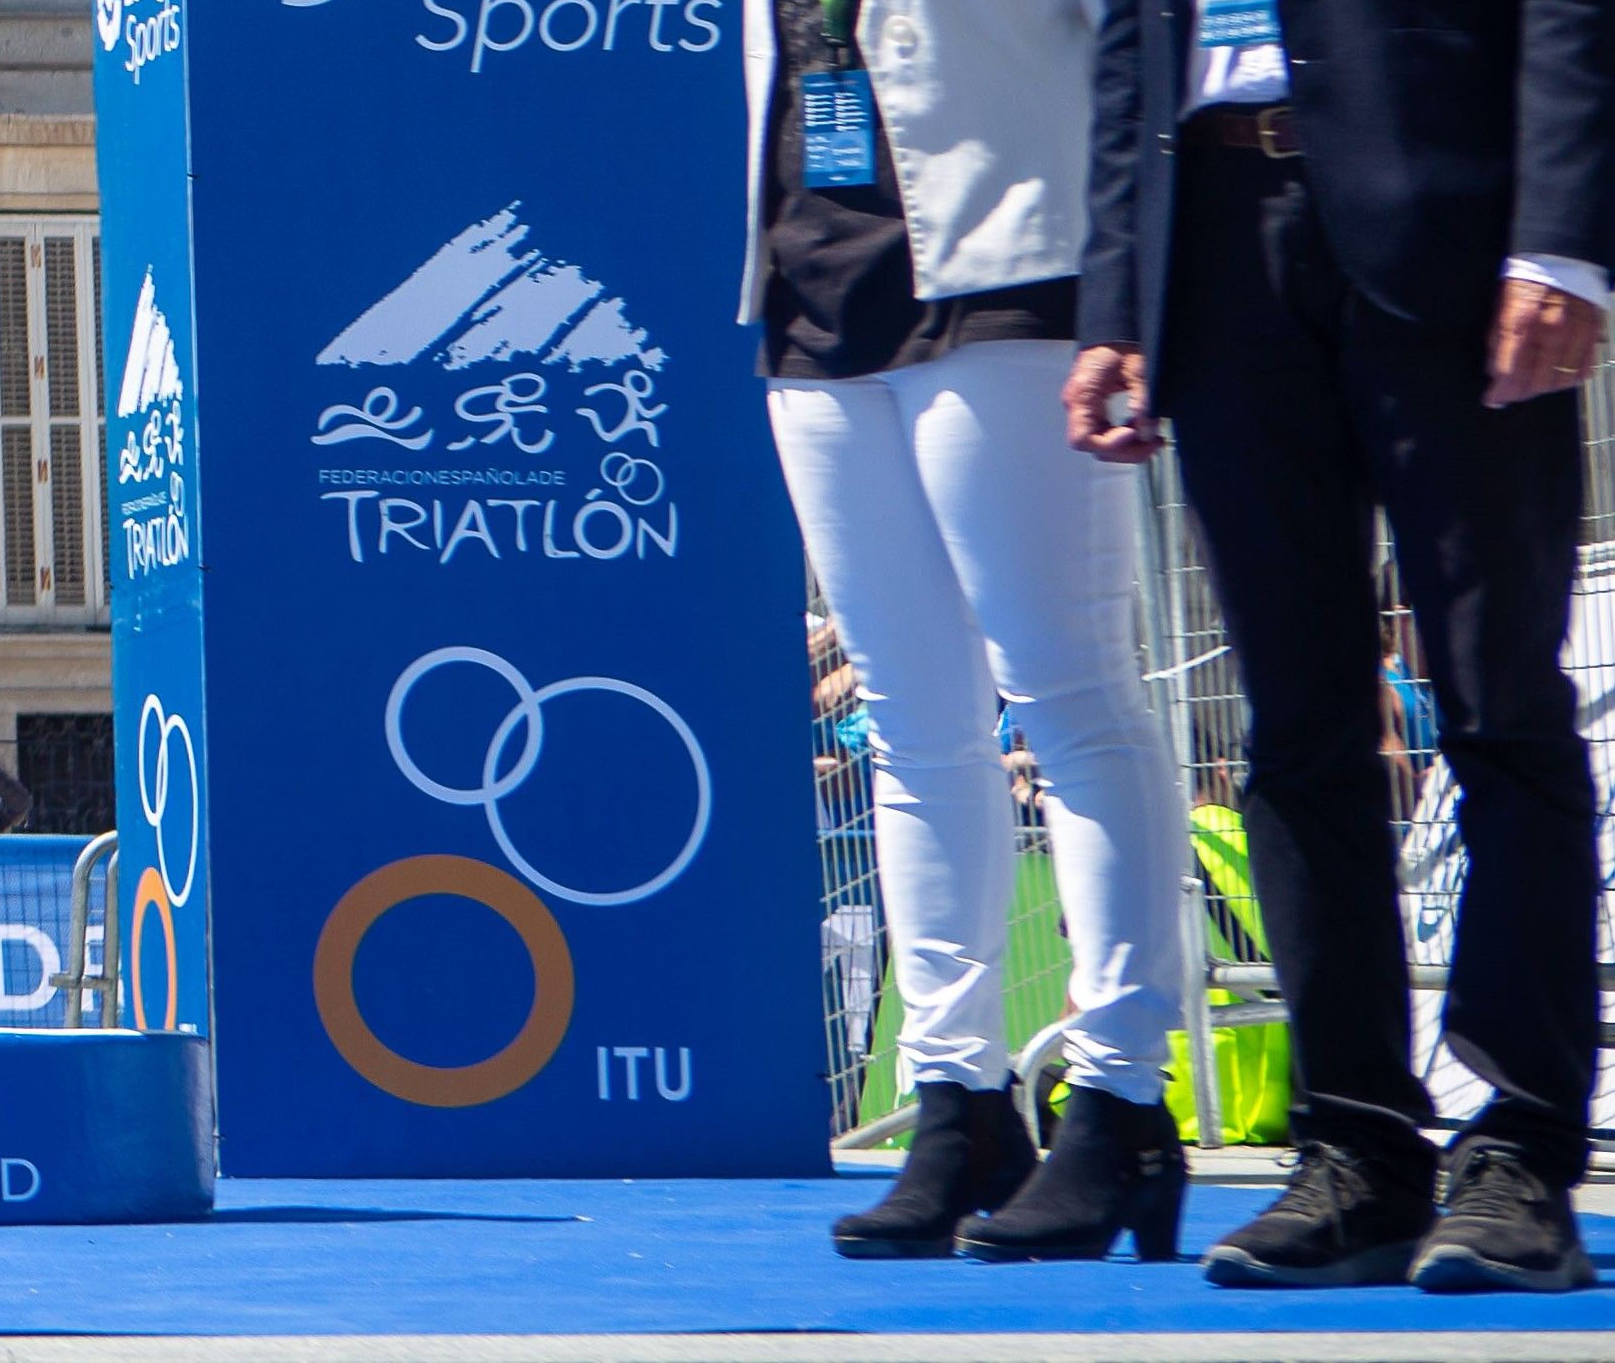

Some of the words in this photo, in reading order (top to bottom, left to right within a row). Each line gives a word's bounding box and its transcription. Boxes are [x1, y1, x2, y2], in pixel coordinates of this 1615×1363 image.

[122, 504, 190, 581] TRIATLÓN
[320, 487, 678, 565] TRIATLÓN
[596, 1045, 693, 1102] ITU
